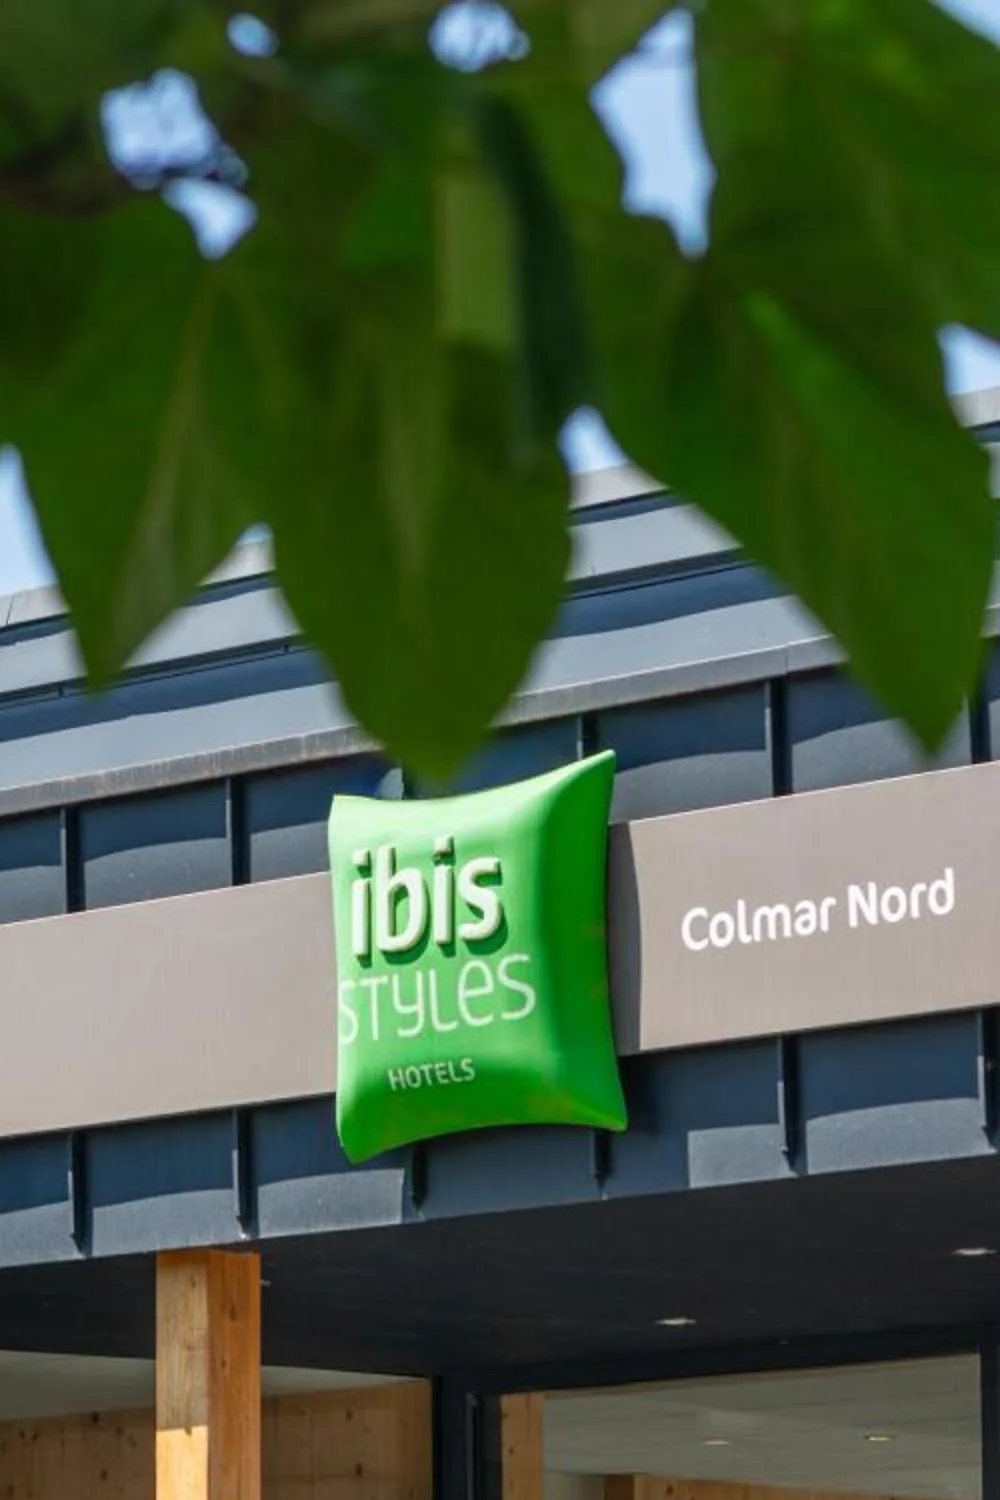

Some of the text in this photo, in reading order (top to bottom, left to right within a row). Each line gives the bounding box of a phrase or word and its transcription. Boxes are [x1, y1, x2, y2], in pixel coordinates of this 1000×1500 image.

[351, 835, 502, 961] ibis
[681, 867, 956, 951] Colmar Nord
[388, 1058, 476, 1091] HOTELS
